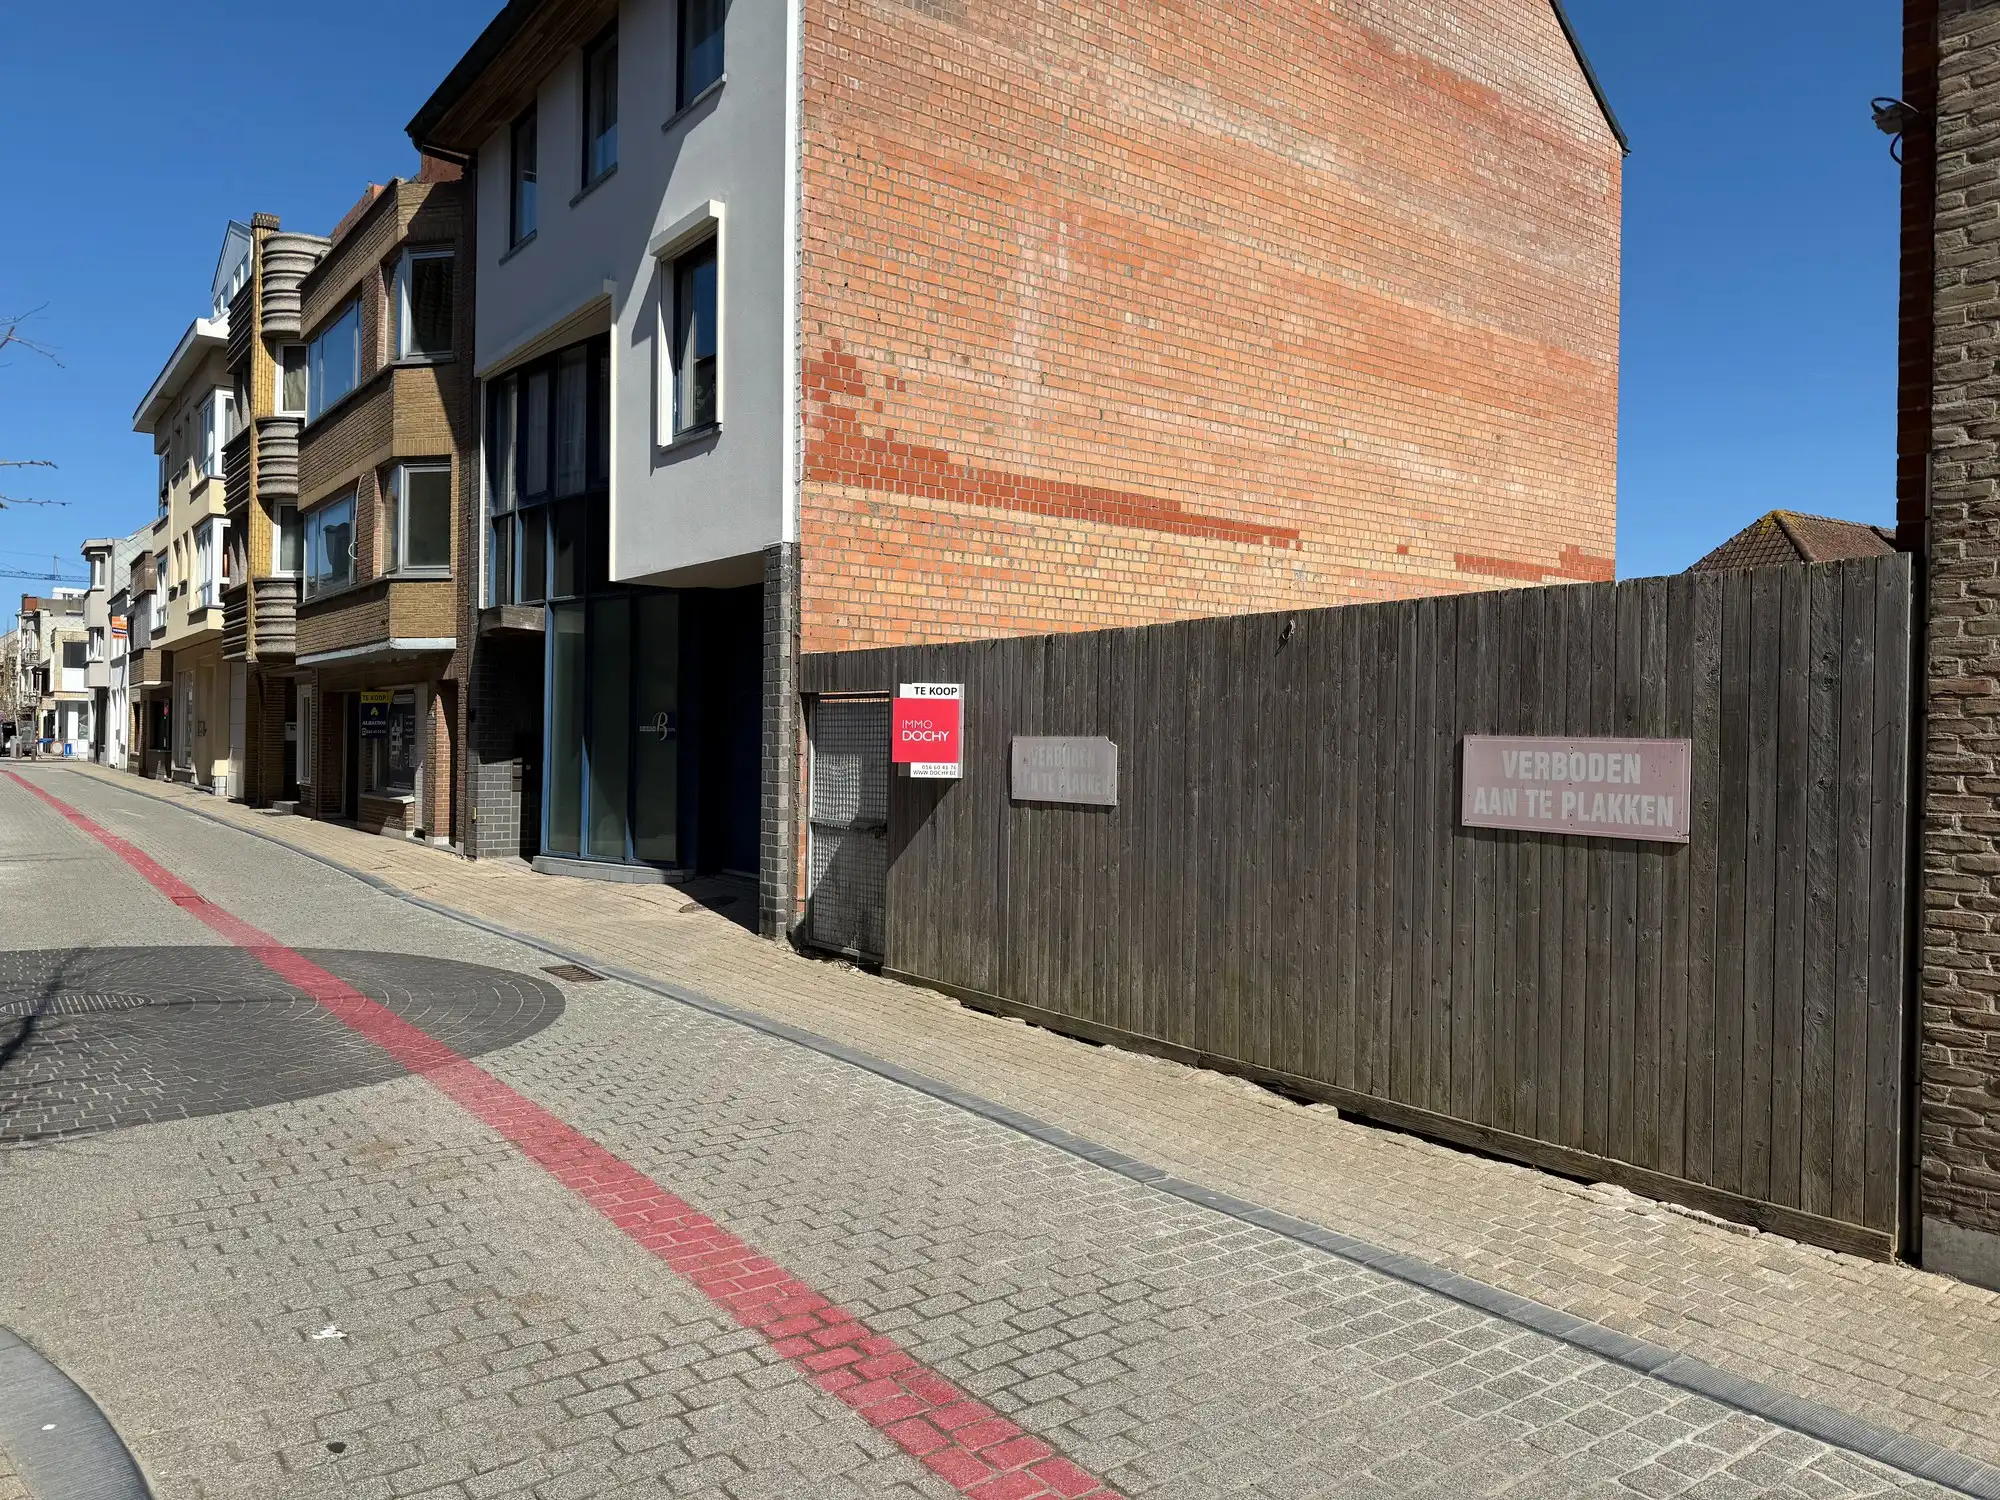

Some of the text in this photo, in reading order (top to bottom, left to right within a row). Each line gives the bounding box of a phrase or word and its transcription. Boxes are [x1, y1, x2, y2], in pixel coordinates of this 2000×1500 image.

[914, 686, 958, 696] TE KOOP
[902, 719, 933, 729] IMMO
[902, 730, 950, 742] DOCHY
[1501, 749, 1641, 785] VERBODEN
[1473, 786, 1674, 828] AAN TE PLAKKEN
